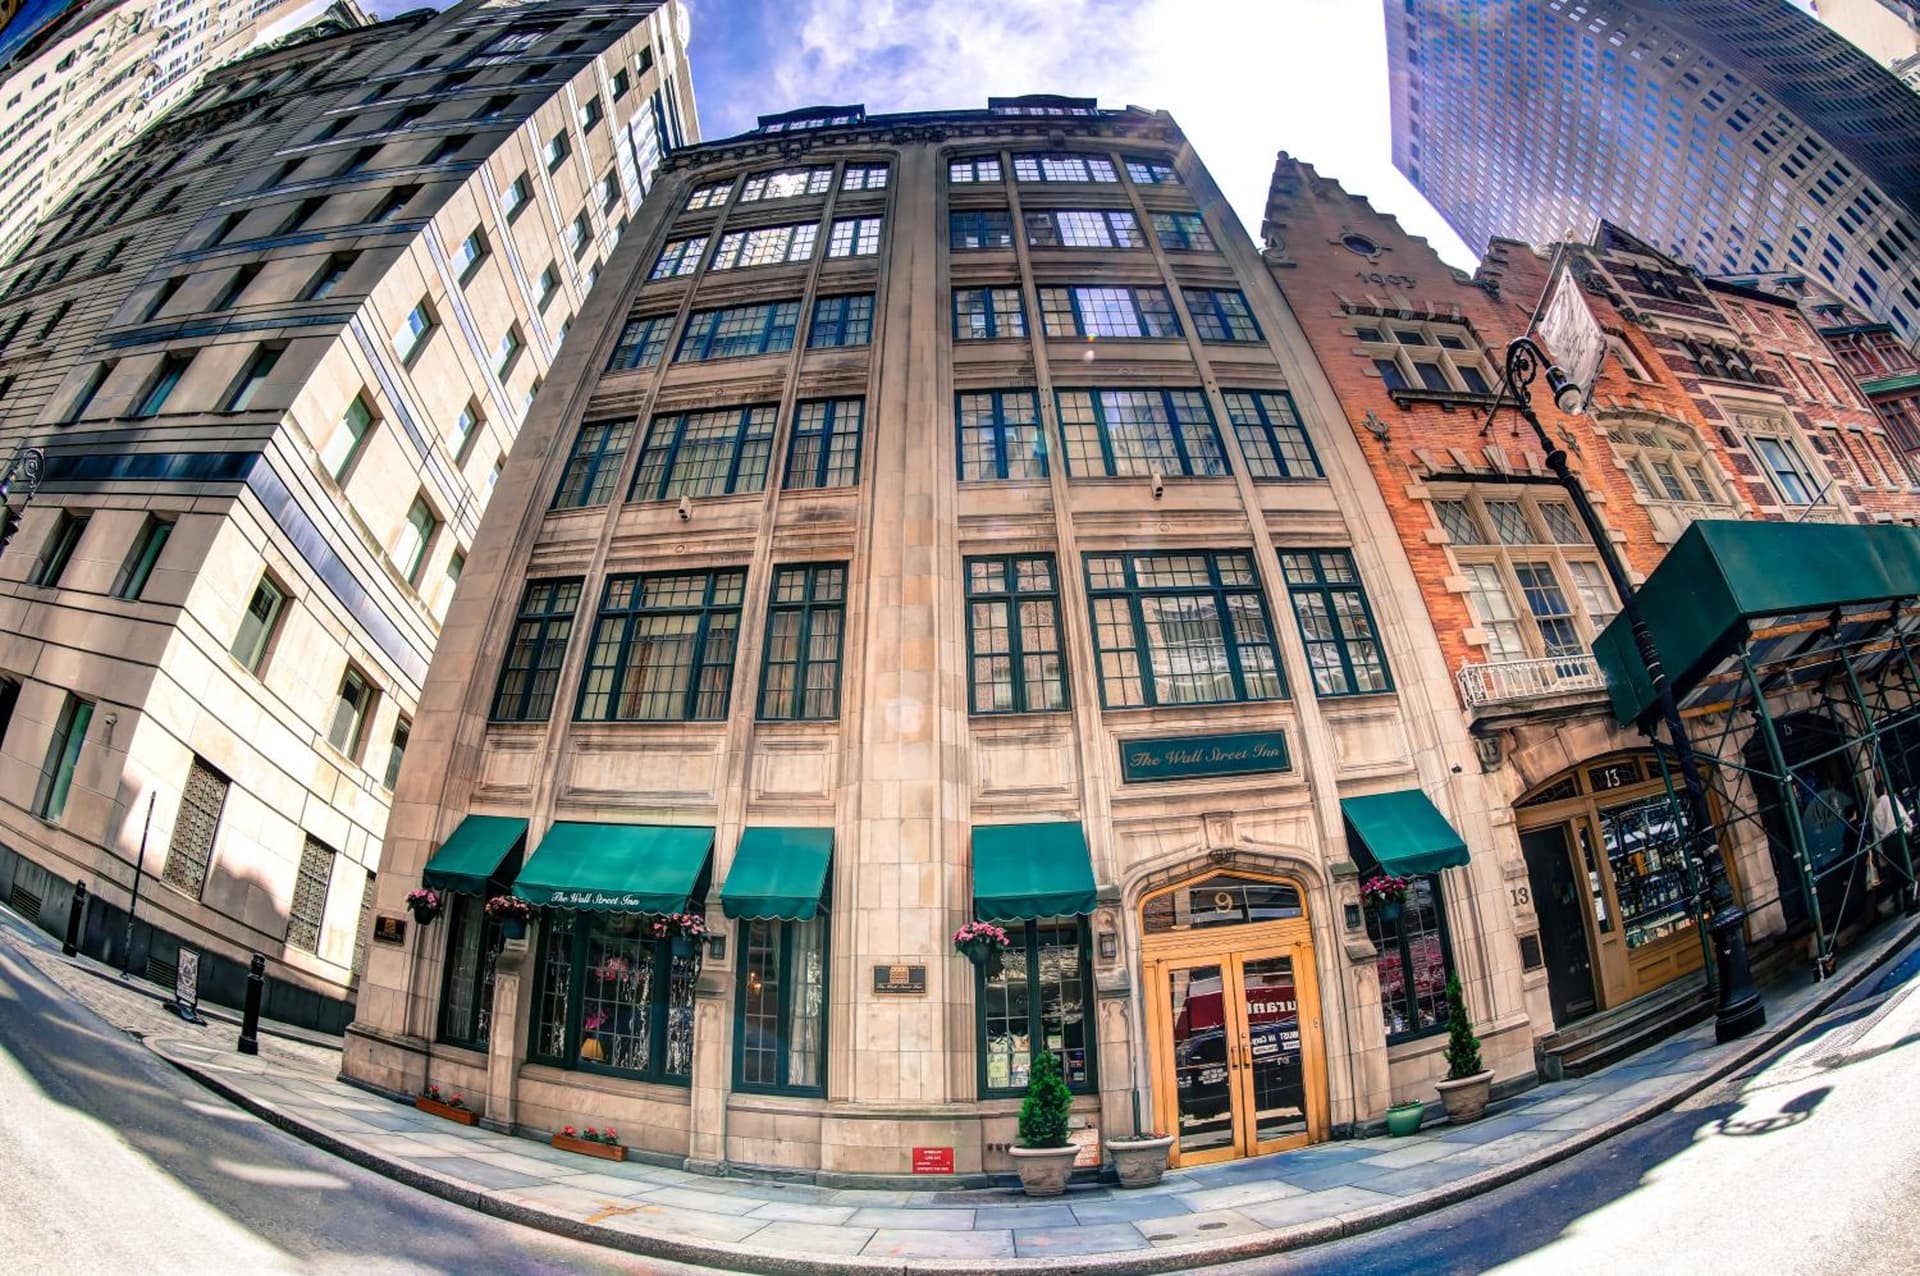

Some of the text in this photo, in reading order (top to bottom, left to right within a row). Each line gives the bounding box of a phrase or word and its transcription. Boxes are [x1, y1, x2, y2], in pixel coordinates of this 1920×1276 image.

[1129, 743, 1280, 767] The Wall Street Inn
[1605, 768, 1620, 788] 13
[551, 891, 640, 905] The Wall Street Inn
[1215, 892, 1232, 913] 9
[1510, 887, 1529, 907] 13
